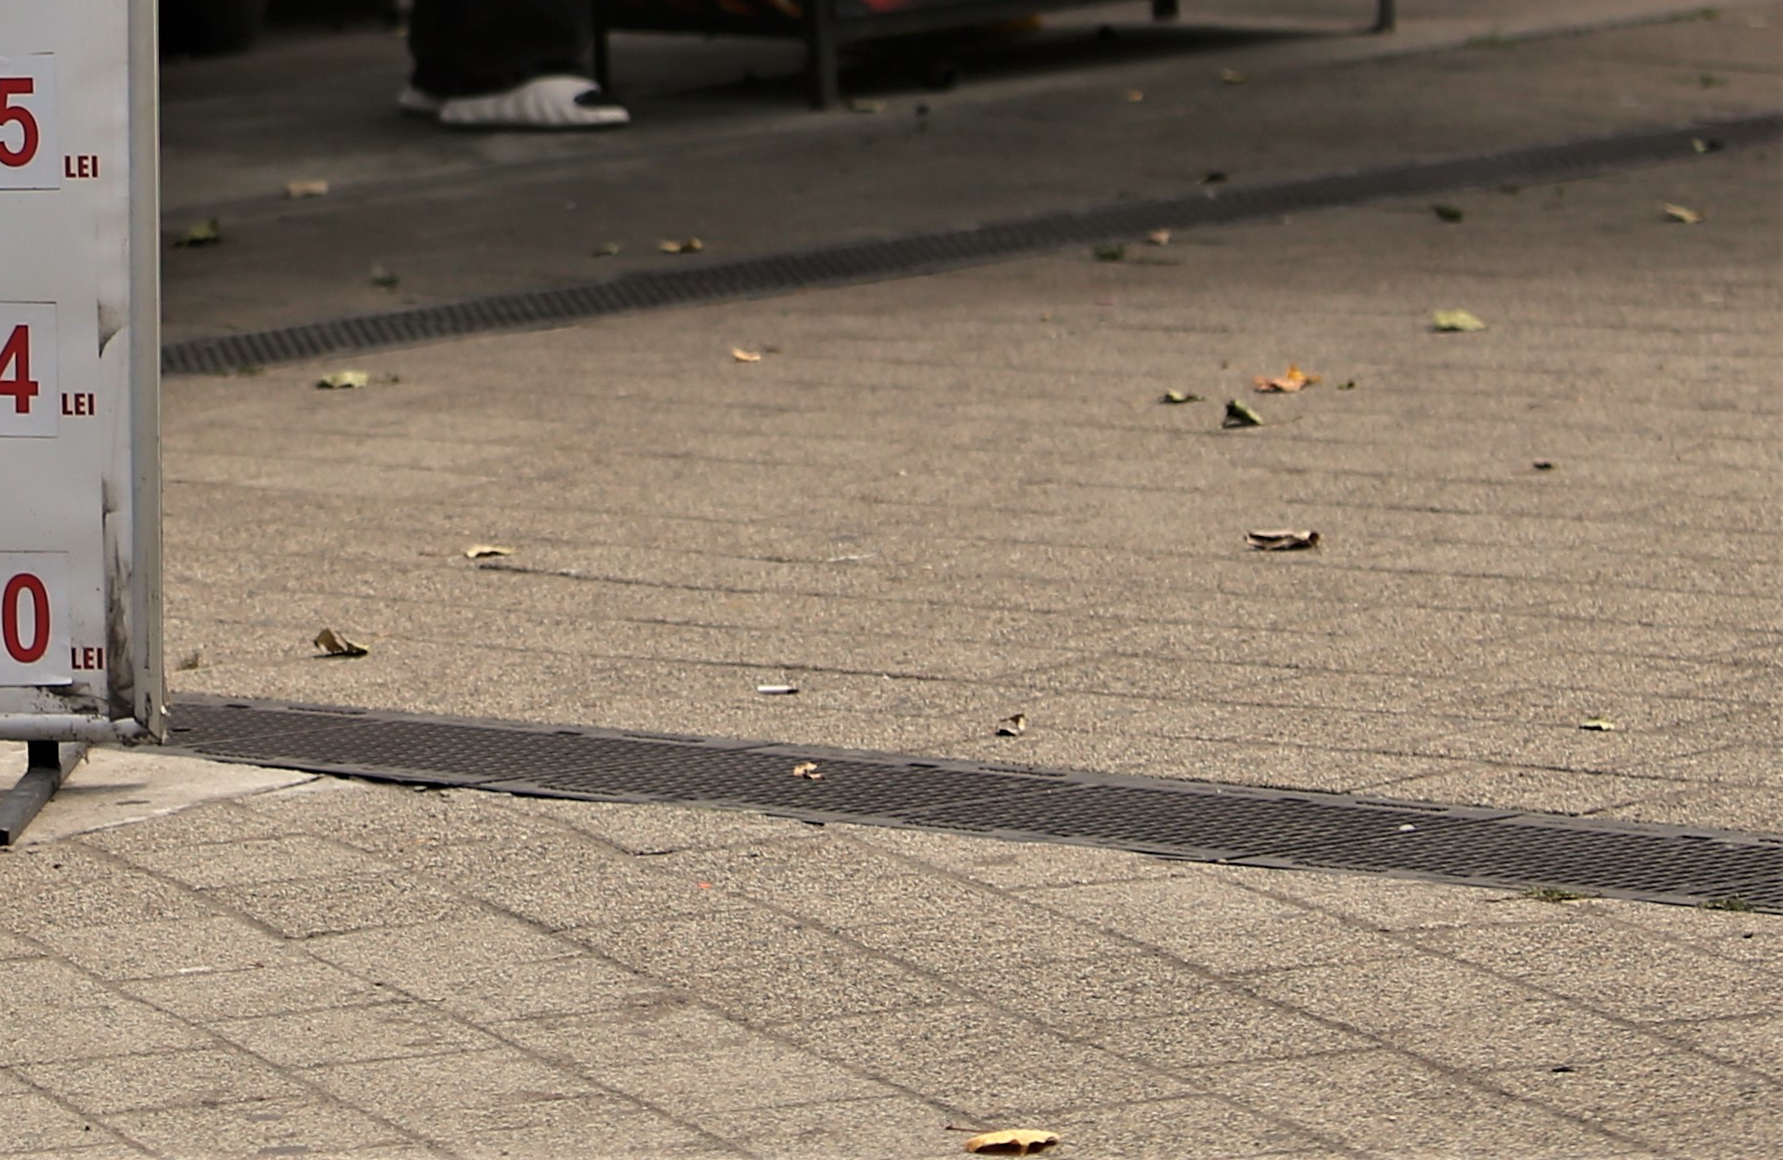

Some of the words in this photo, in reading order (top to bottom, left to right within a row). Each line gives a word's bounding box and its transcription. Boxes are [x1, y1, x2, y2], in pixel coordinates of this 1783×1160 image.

[65, 156, 97, 177] LEI
[62, 393, 94, 415] LEI
[72, 648, 105, 669] LEI
